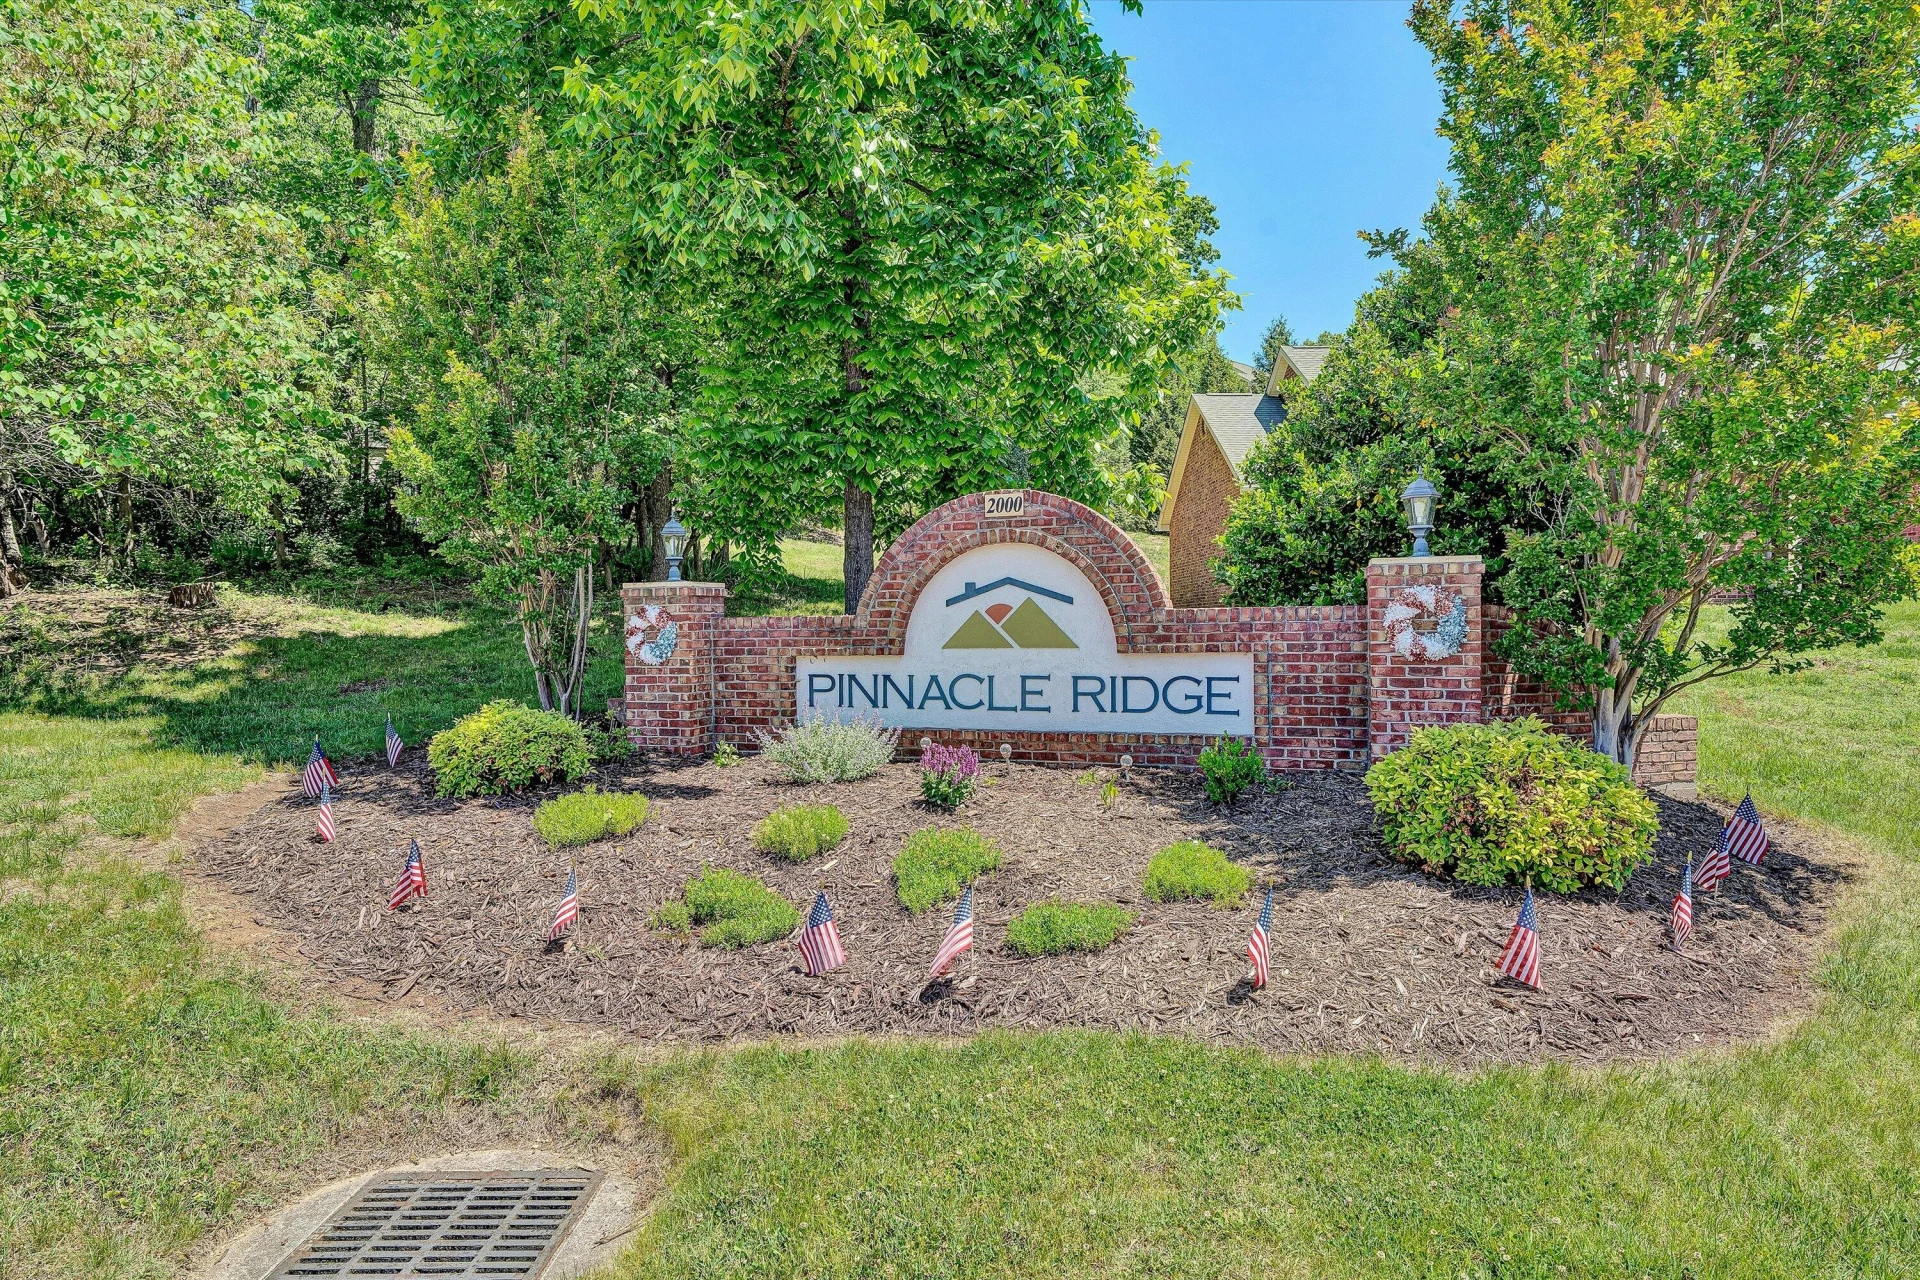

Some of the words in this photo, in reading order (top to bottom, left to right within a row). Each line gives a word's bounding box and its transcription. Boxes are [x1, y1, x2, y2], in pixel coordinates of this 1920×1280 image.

[986, 496, 1023, 513] 2000
[807, 673, 1052, 713] PINNACLE
[1071, 675, 1241, 717] RIDGE
